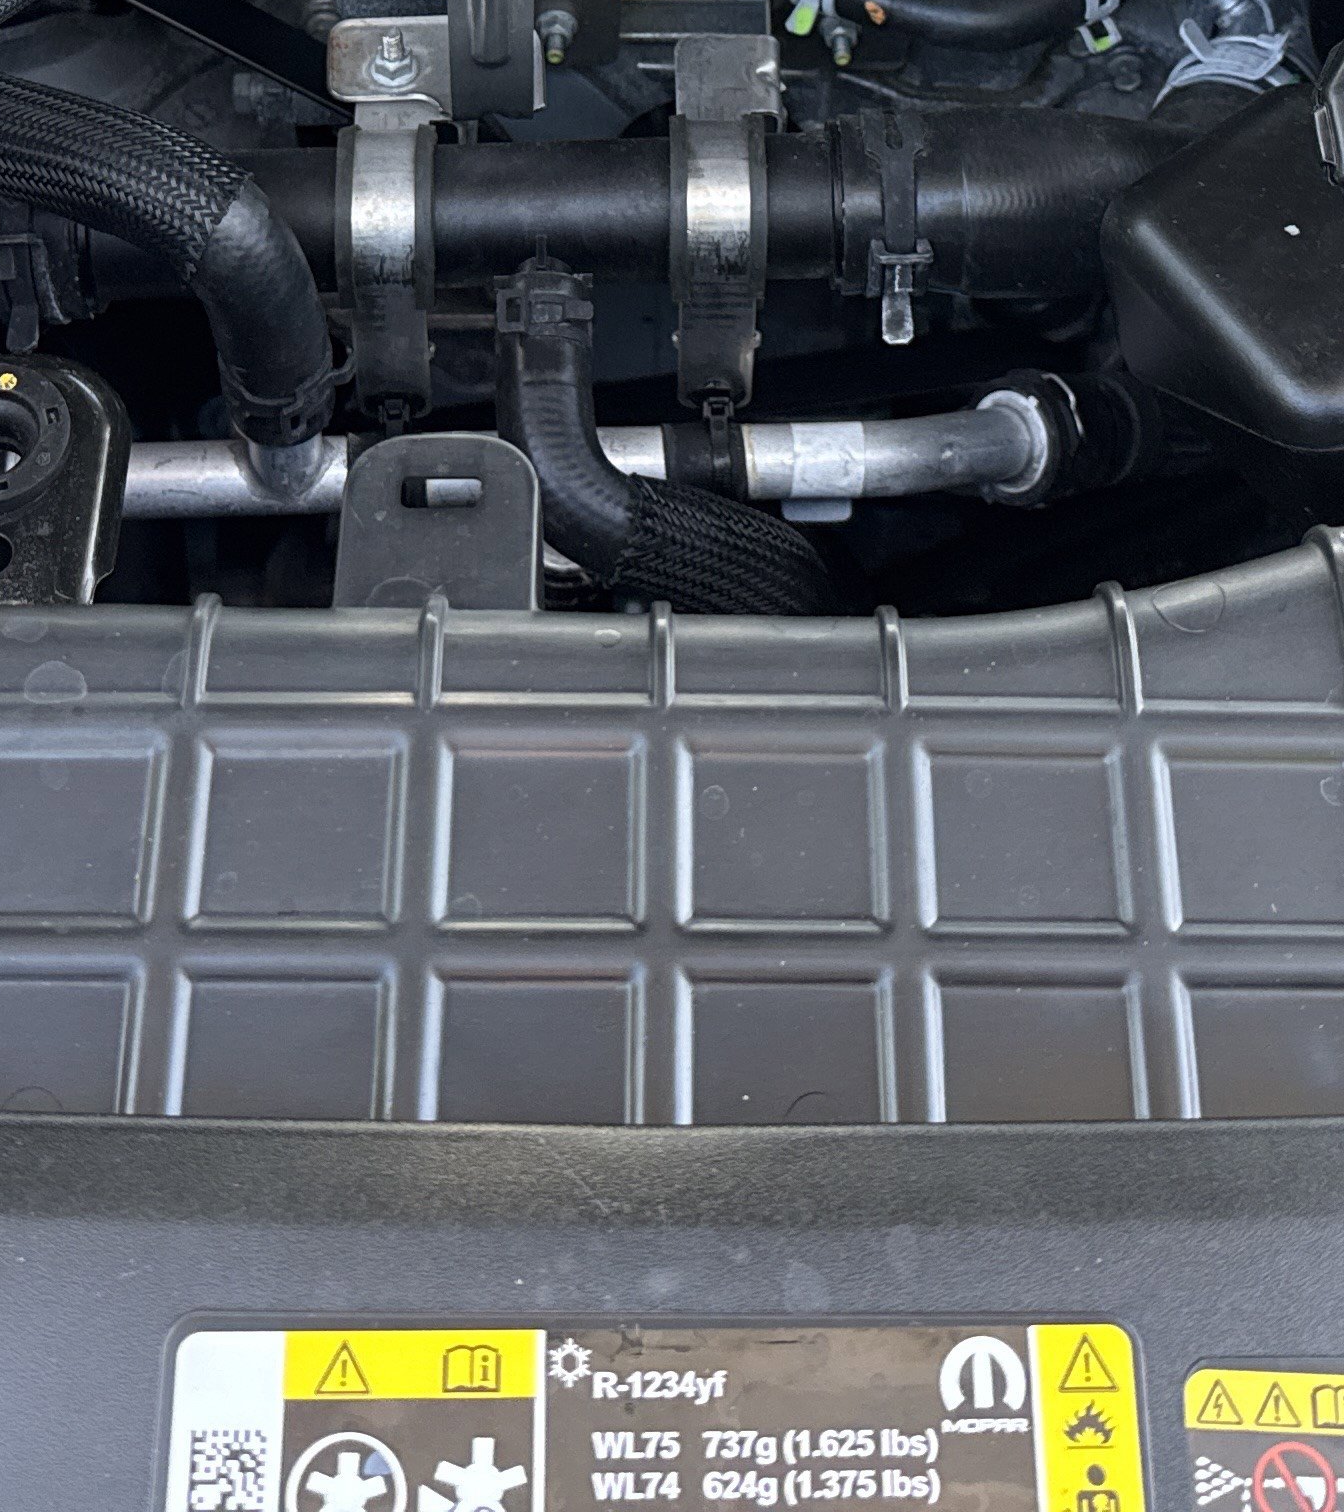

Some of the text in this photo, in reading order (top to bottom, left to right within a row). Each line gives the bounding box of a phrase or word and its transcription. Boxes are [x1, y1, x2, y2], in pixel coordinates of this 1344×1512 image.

[592, 1370, 729, 1406] R-1234yf
[941, 1417, 1031, 1435] MOPAR
[592, 1428, 939, 1464] WL75 737g (1.625 lbs)
[592, 1468, 941, 1504] WL74 624g (1.375 lbs)
